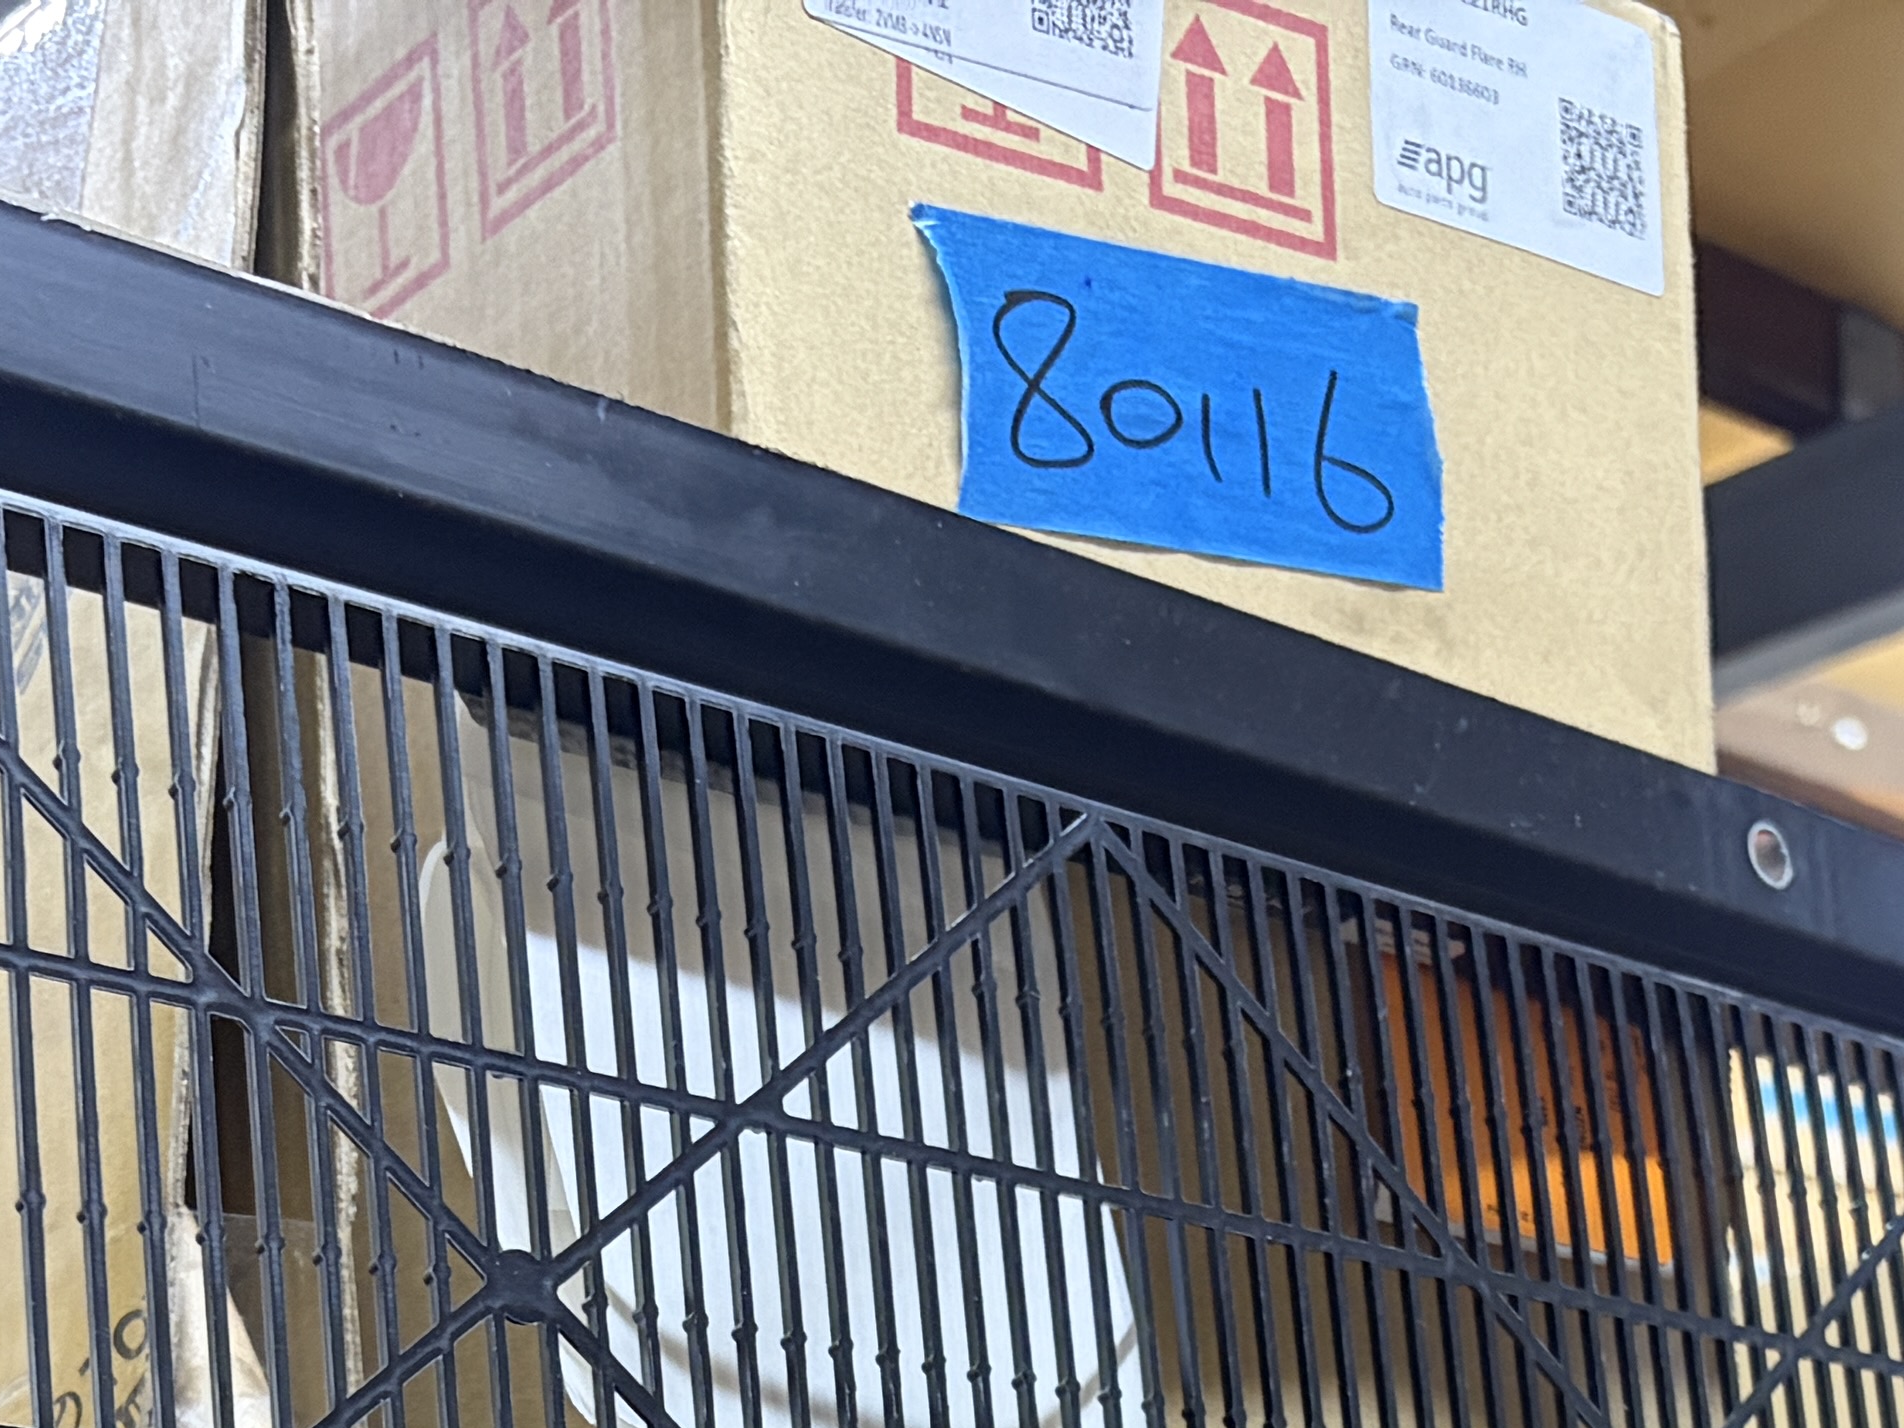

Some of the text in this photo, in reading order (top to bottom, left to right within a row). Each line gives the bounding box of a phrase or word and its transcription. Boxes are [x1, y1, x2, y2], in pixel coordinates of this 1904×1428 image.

[1390, 13, 1421, 40] Rear
[1424, 27, 1468, 57] Guard
[1424, 146, 1488, 204] apg
[992, 289, 1395, 534] 80116
